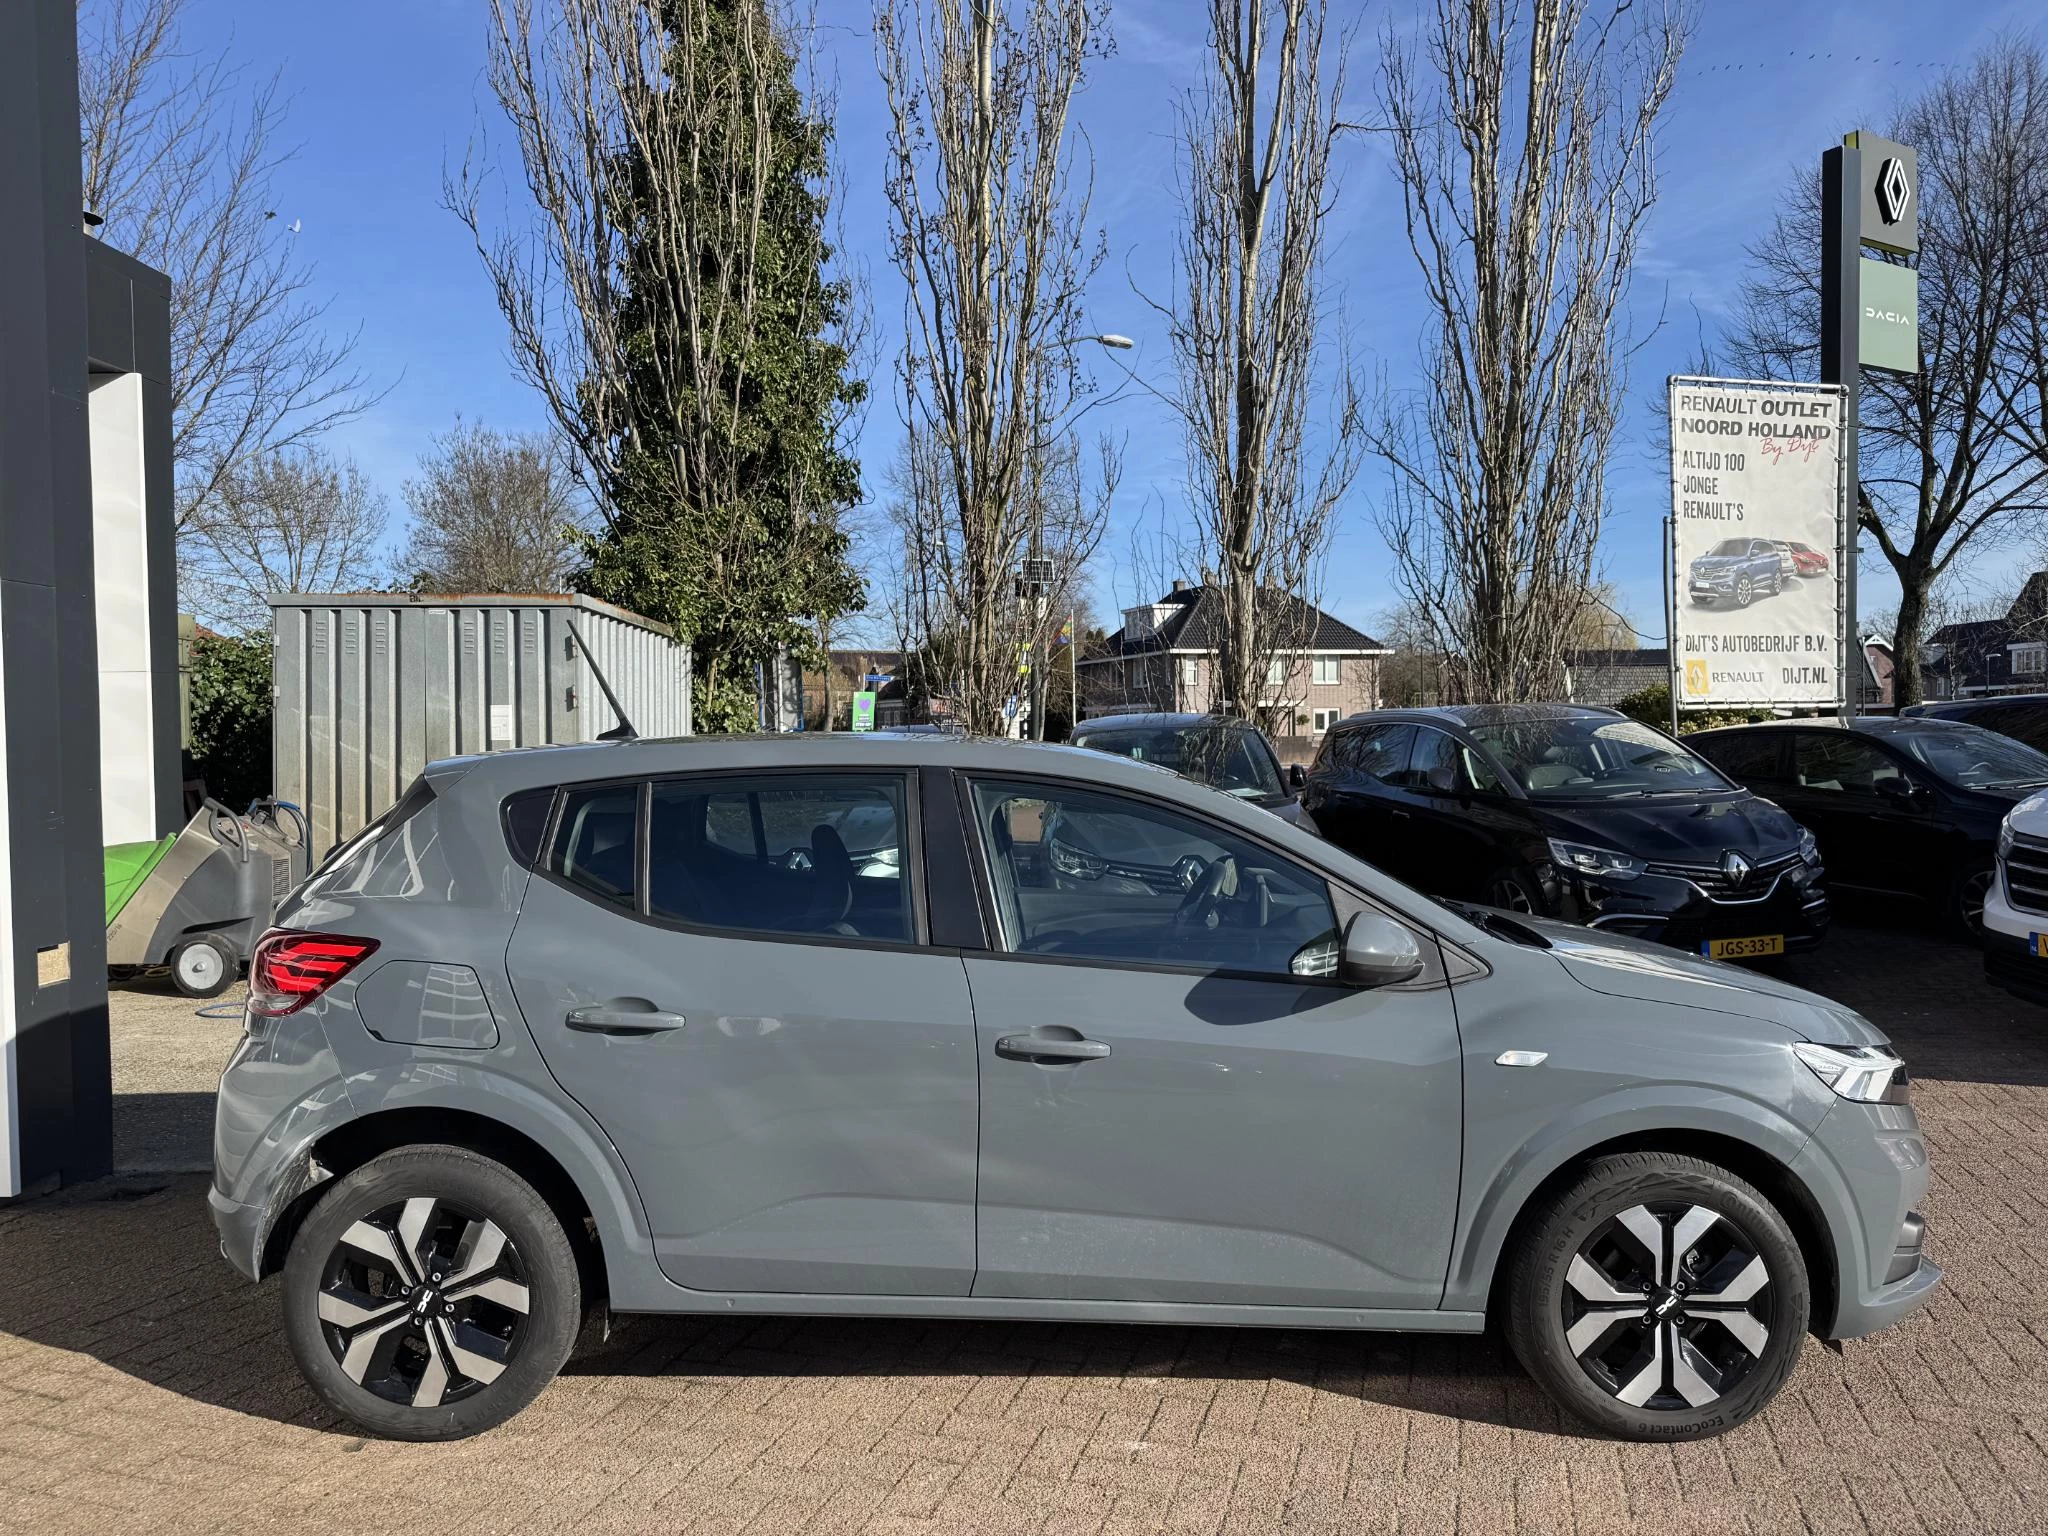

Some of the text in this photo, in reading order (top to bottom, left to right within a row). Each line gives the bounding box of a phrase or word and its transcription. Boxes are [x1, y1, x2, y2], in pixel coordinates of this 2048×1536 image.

[1865, 307, 1910, 325] DACIA
[1681, 395, 1833, 418] RENAULT OUTLET
[1681, 418, 1831, 440] NOORD HOLLAND
[1682, 450, 1745, 472] ALTIJD 100
[1760, 437, 1783, 465] By
[1683, 475, 1719, 495] JONGE
[1683, 500, 1744, 521] RENAULT'S
[1685, 634, 1828, 652] DIJT'S AUTOBEDRIJF B.V.
[1712, 667, 1828, 684] RENAULT DIJT.NL
[1717, 937, 1777, 956] JGS-33-T
[1638, 1415, 1724, 1435] EcoContact 6
